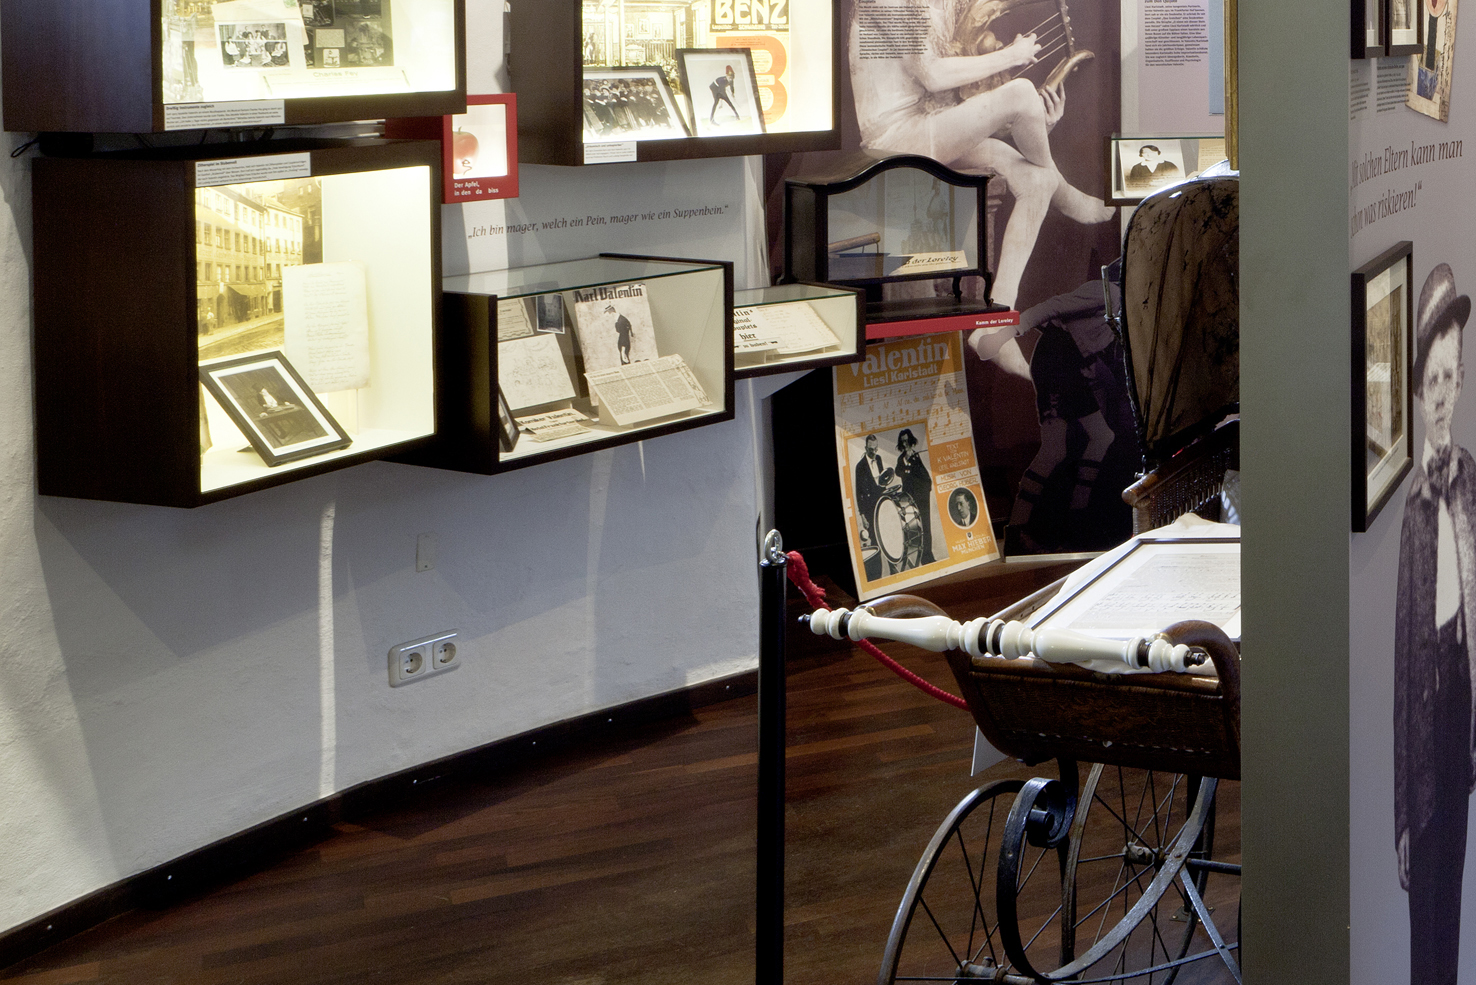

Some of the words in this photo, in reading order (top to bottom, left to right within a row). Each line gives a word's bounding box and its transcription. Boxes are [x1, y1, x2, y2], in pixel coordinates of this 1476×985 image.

[1383, 145, 1408, 174] Eltern
[1410, 140, 1436, 166] kann
[1438, 140, 1463, 161] man
[489, 223, 504, 237] bin
[506, 222, 539, 237] mager,
[542, 217, 568, 230] welch
[570, 216, 584, 228] ein
[585, 214, 608, 227] Pein,
[610, 213, 639, 228] mager
[641, 210, 655, 221] wie
[658, 208, 671, 220] ein
[574, 287, 599, 304] Karl
[599, 284, 643, 301] Valentin
[863, 372, 889, 388] Liesl
[890, 364, 938, 383] Karlstadt
[959, 469, 972, 477] VON
[951, 542, 967, 553] MAX
[967, 535, 992, 547] HIEBER
